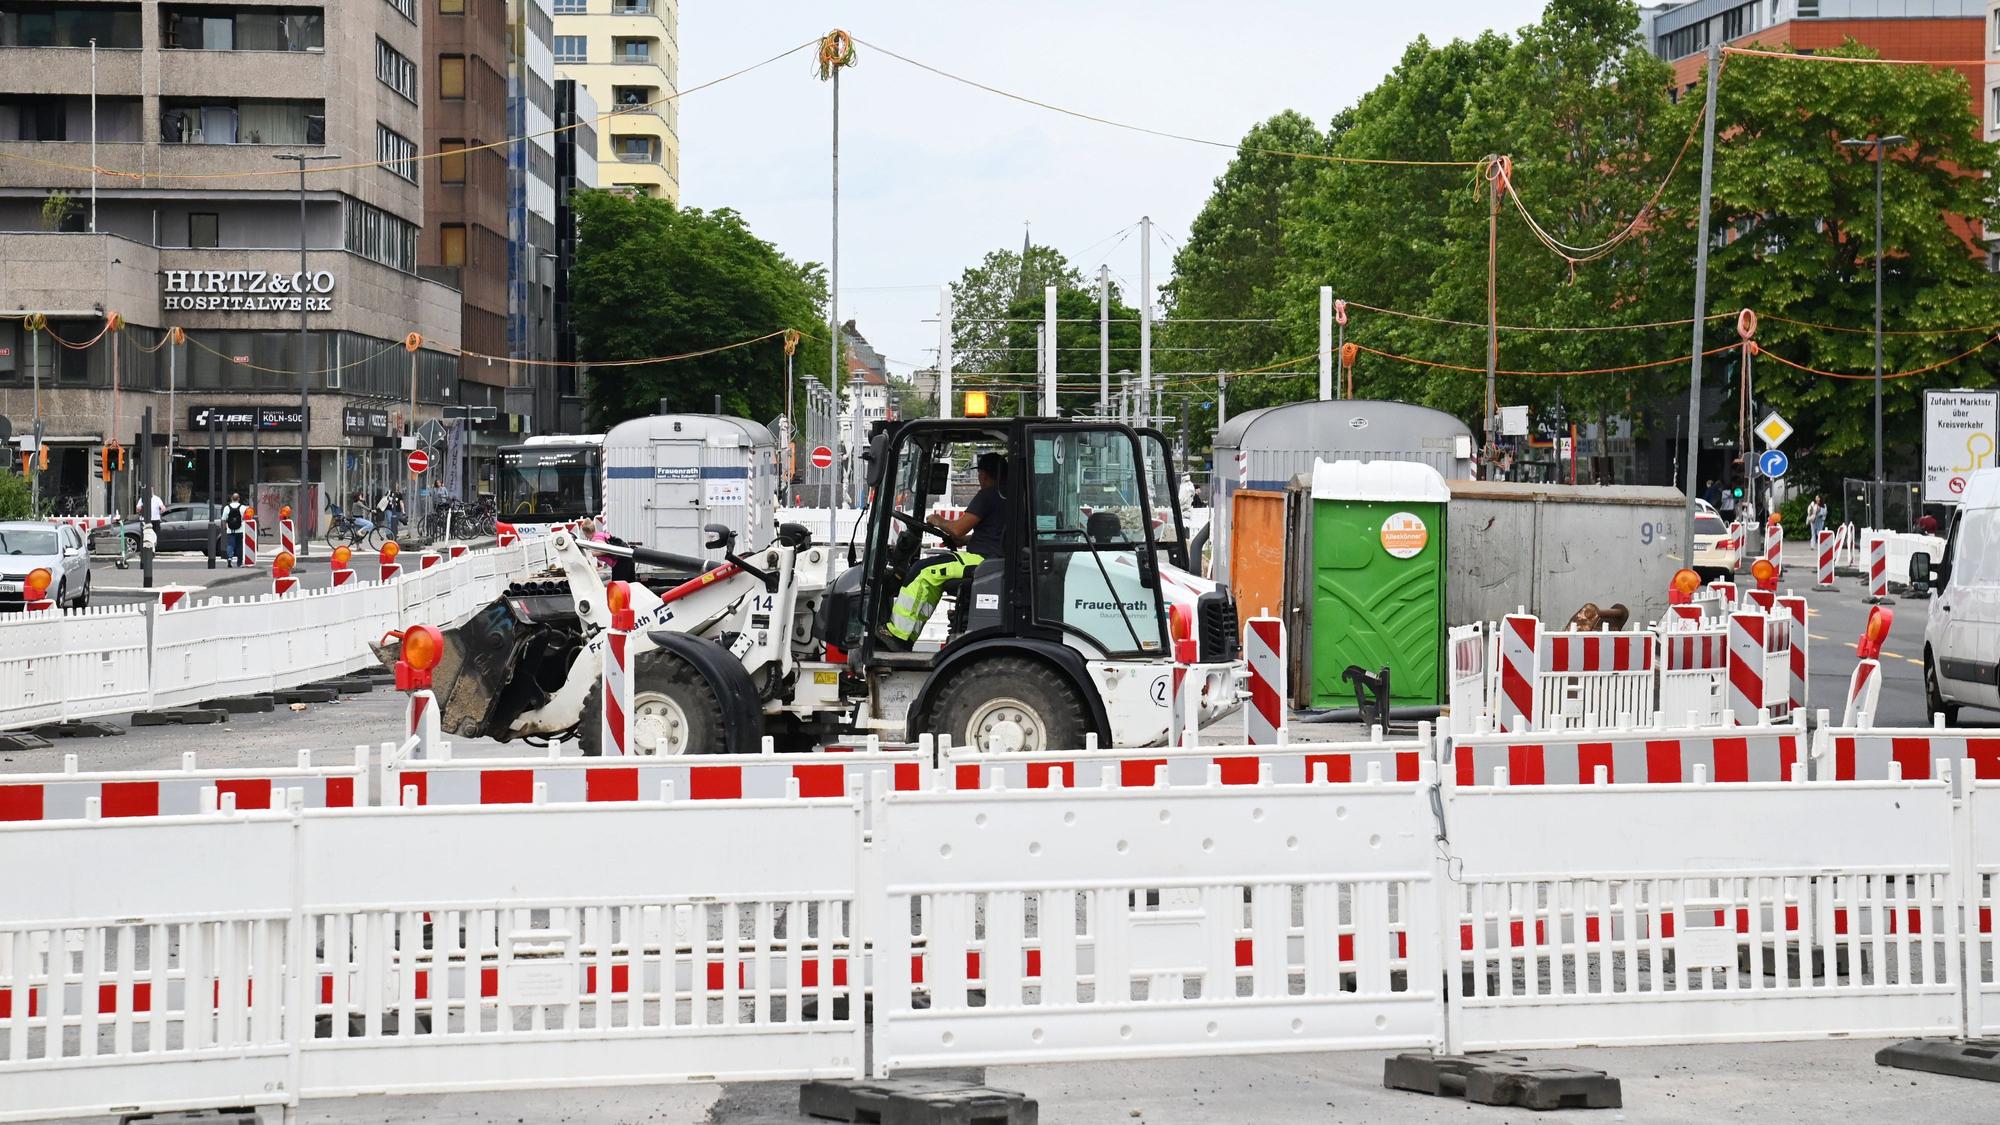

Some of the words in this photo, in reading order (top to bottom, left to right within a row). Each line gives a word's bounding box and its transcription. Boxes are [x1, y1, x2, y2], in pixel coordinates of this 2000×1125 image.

[164, 270, 335, 293] HIRTZ&CO
[164, 296, 332, 310] HOSPITALWERK
[1930, 397, 1957, 406] Zufahrt
[1960, 398, 1992, 407] Marktstr.
[1952, 409, 1969, 417] über
[1938, 420, 1984, 429] Kreisverkehr
[657, 467, 699, 475] Frauenrath
[753, 594, 773, 612] 14
[1157, 681, 1166, 701] 2
